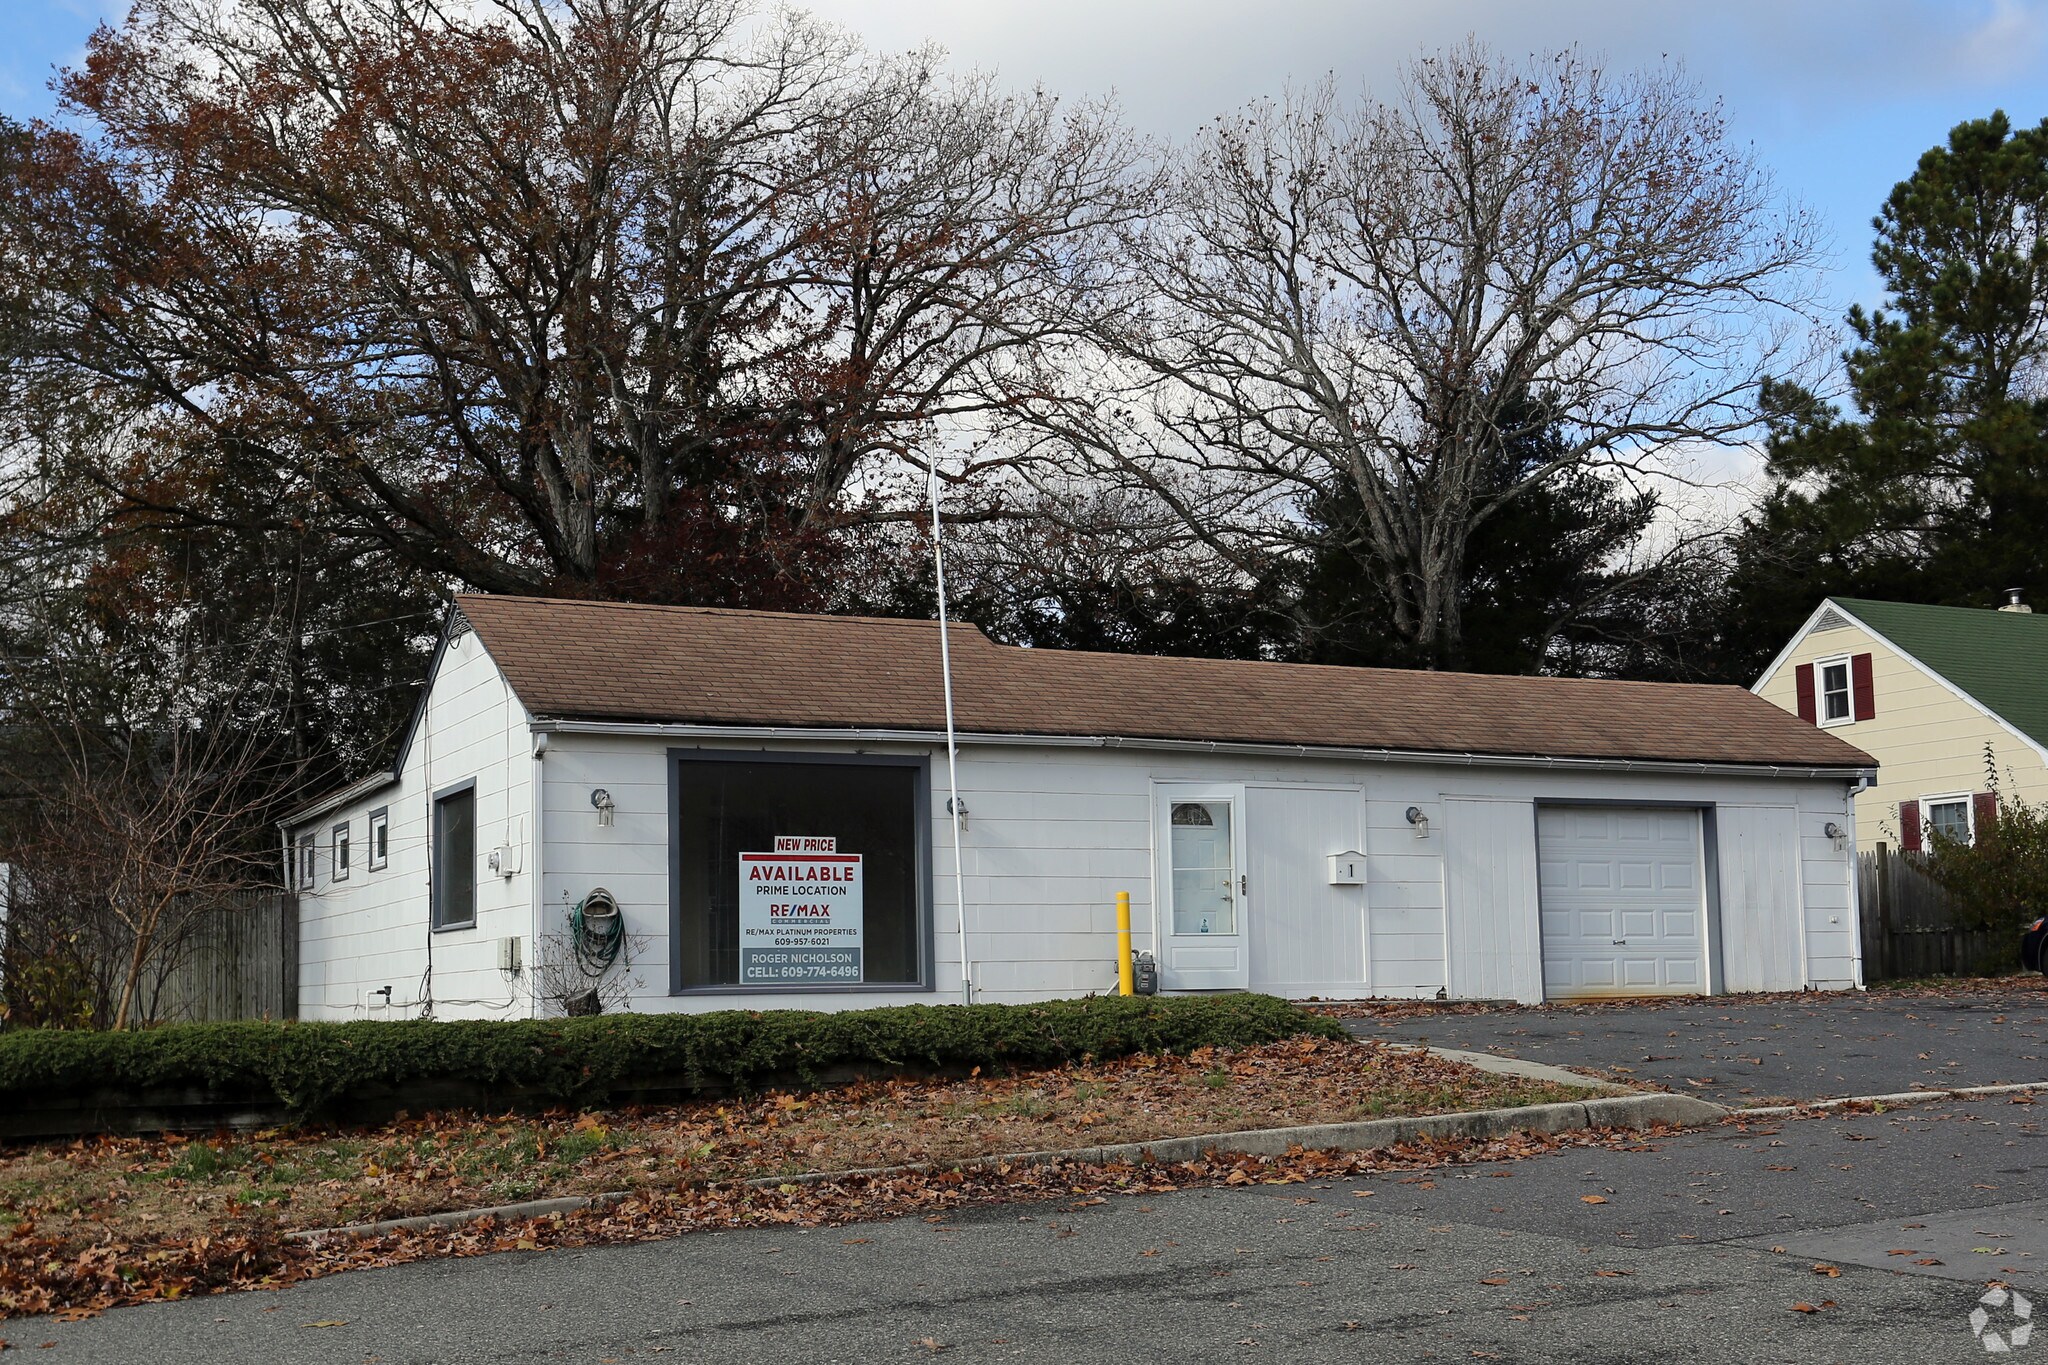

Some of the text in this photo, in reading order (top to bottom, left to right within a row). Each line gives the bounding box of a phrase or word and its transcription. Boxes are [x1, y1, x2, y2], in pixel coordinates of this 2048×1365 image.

[777, 838, 834, 851] NEW PRICE
[749, 866, 854, 881] AVAILABLE
[756, 885, 847, 895] PRIME LOCATION
[770, 904, 830, 917] RE/MAX
[814, 928, 858, 936] PROPERTIES
[751, 953, 852, 963] ROGER NICHOLSON
[747, 966, 859, 977] CELL: 609-774-6496
